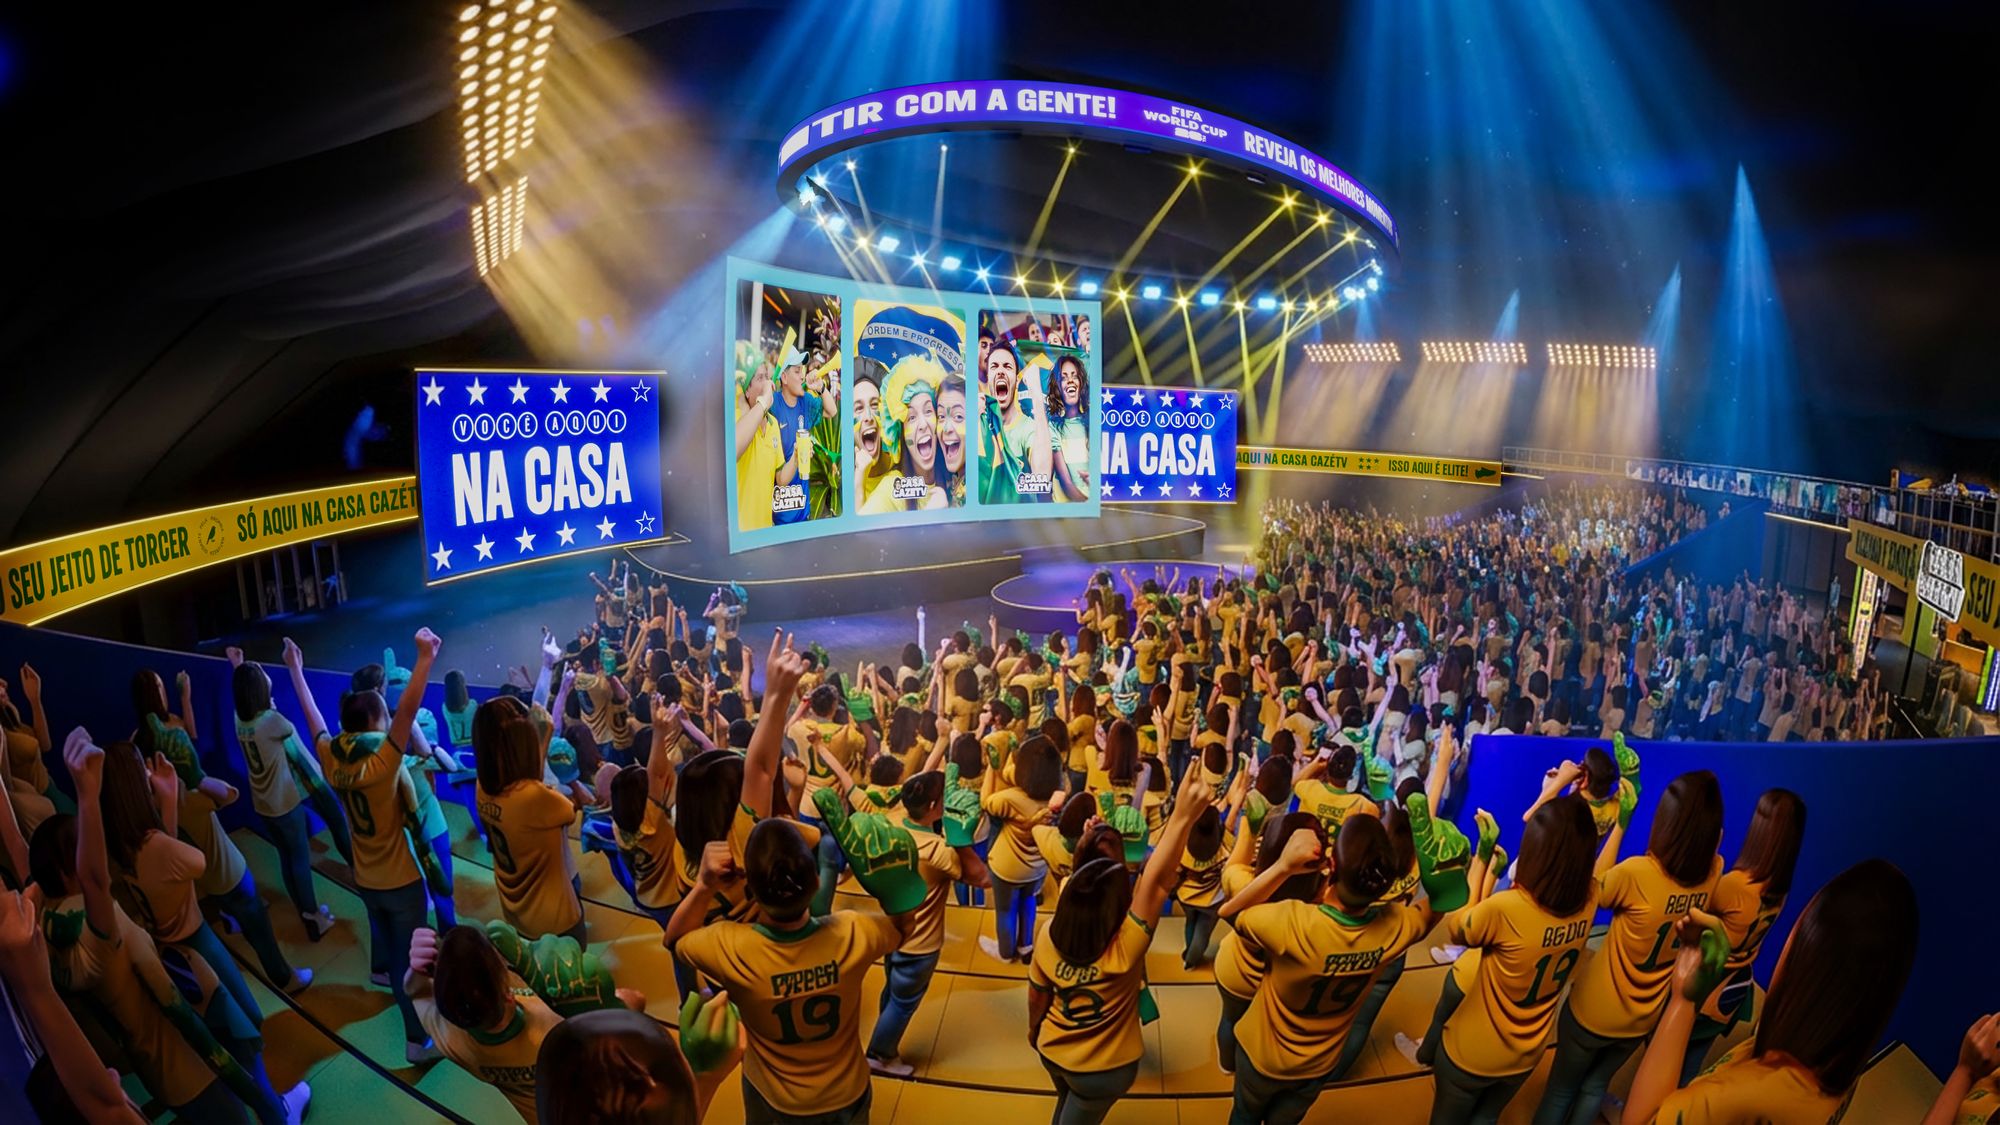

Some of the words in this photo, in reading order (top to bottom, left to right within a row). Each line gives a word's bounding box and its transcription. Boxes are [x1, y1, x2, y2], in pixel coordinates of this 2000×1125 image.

[896, 90, 976, 117] COM
[987, 89, 1008, 111] A
[1017, 89, 1116, 119] GENTE!
[1171, 106, 1202, 122] FIFA
[1144, 110, 1199, 131] WORLD
[1201, 124, 1228, 138] CUP
[1244, 130, 1298, 170] REVEJA
[1300, 155, 1316, 179] OS
[1318, 163, 1365, 208] MELHORES
[867, 325, 899, 337] ORDEM
[903, 330, 908, 338] E
[456, 413, 534, 441] VOCÊ
[548, 411, 622, 434] AQUI
[1106, 411, 1148, 426] OCÊ
[1157, 412, 1213, 428] AQUI
[1139, 432, 1216, 476] CASA
[1236, 452, 1260, 464] AQUI
[1264, 452, 1278, 465] NA
[1281, 453, 1307, 466] CASA
[1311, 453, 1347, 468] CAZÉTV
[1388, 459, 1409, 472] ISSO
[1412, 461, 1432, 474] AQUI
[1435, 460, 1440, 475] É
[1443, 462, 1469, 477] ELITE!
[452, 450, 514, 526] NA
[524, 442, 632, 515] CASA
[901, 477, 925, 488] CASA
[237, 505, 257, 542] SÓ
[263, 503, 298, 535] AQUI
[302, 501, 323, 528] NA
[327, 494, 366, 522] CASA
[370, 483, 416, 514] CAZÉT
[8, 561, 45, 610] SEU
[49, 547, 96, 597] JEITO
[99, 541, 123, 580] DE
[124, 526, 191, 571] TORCER
[771, 994, 841, 1044] 19
